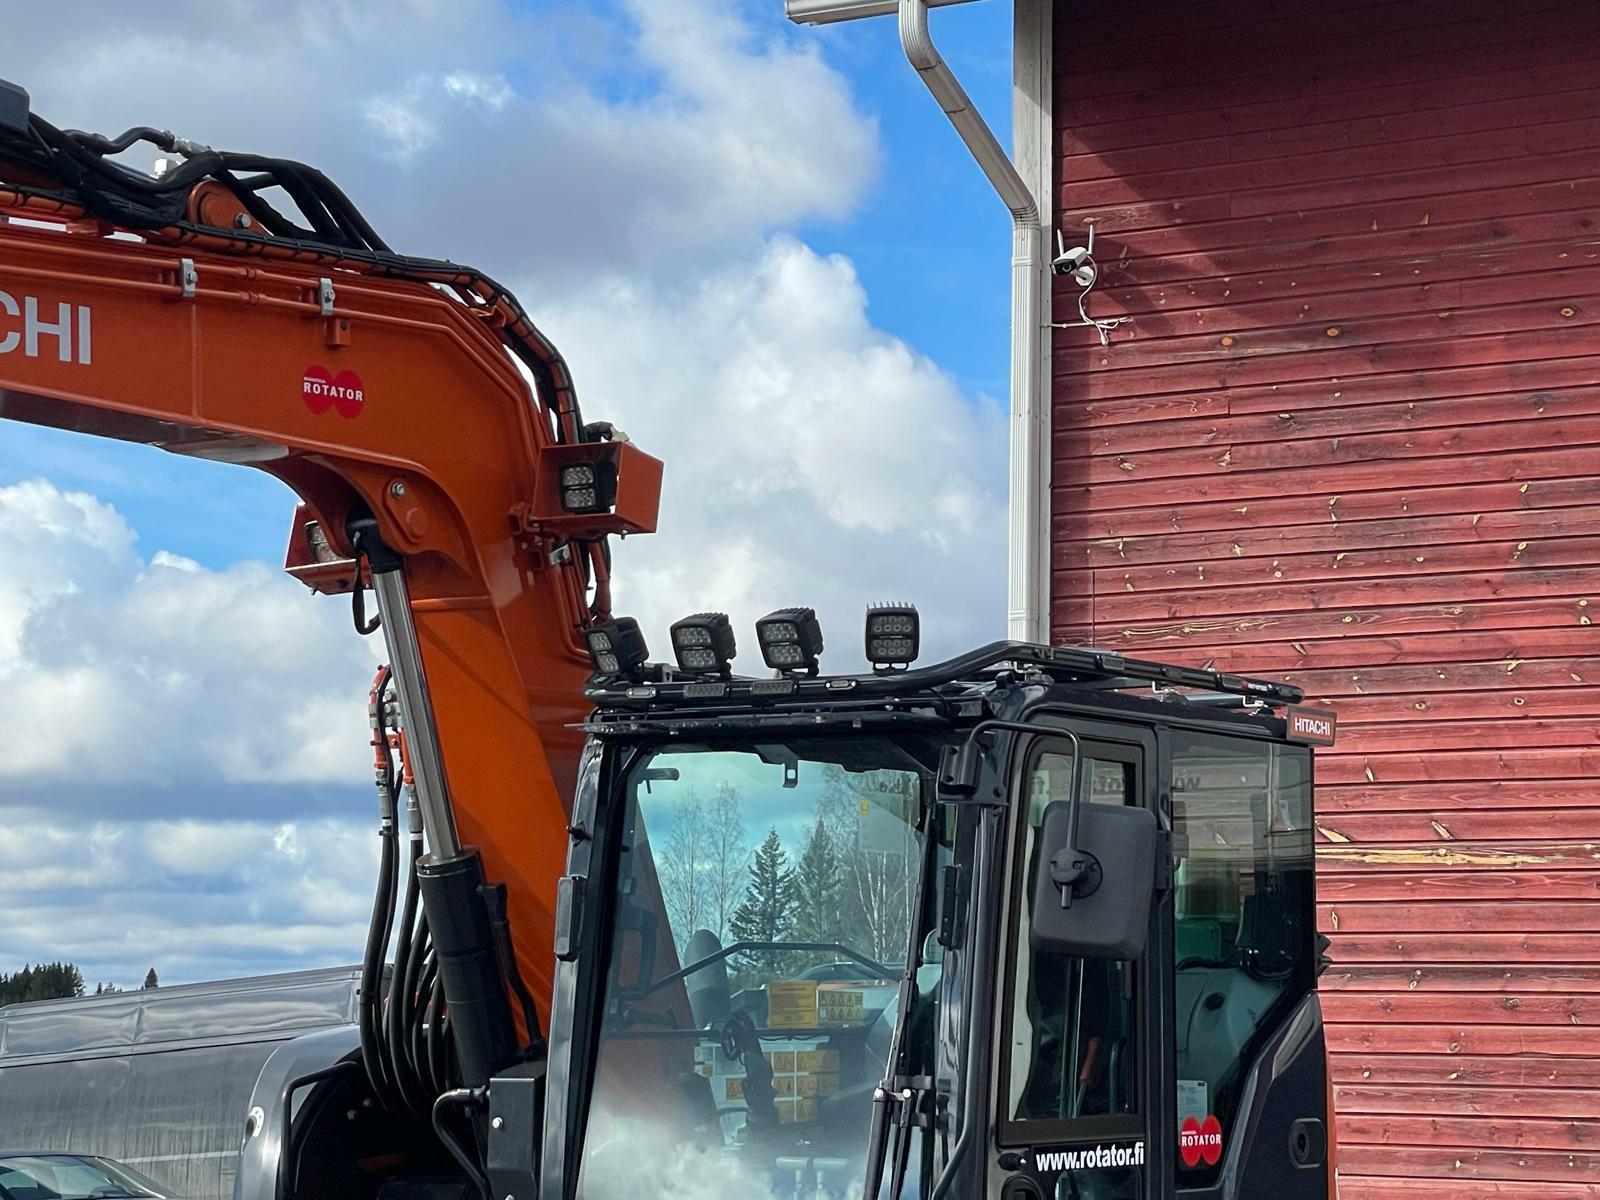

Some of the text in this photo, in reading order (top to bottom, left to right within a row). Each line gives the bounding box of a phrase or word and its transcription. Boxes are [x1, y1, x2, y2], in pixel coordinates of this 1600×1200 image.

[303, 381, 363, 402] ROTATOR
[1294, 717, 1331, 736] HITACHI
[1181, 1133, 1221, 1147] ROTATOR
[1035, 1141, 1145, 1172] www.rotator.fi
